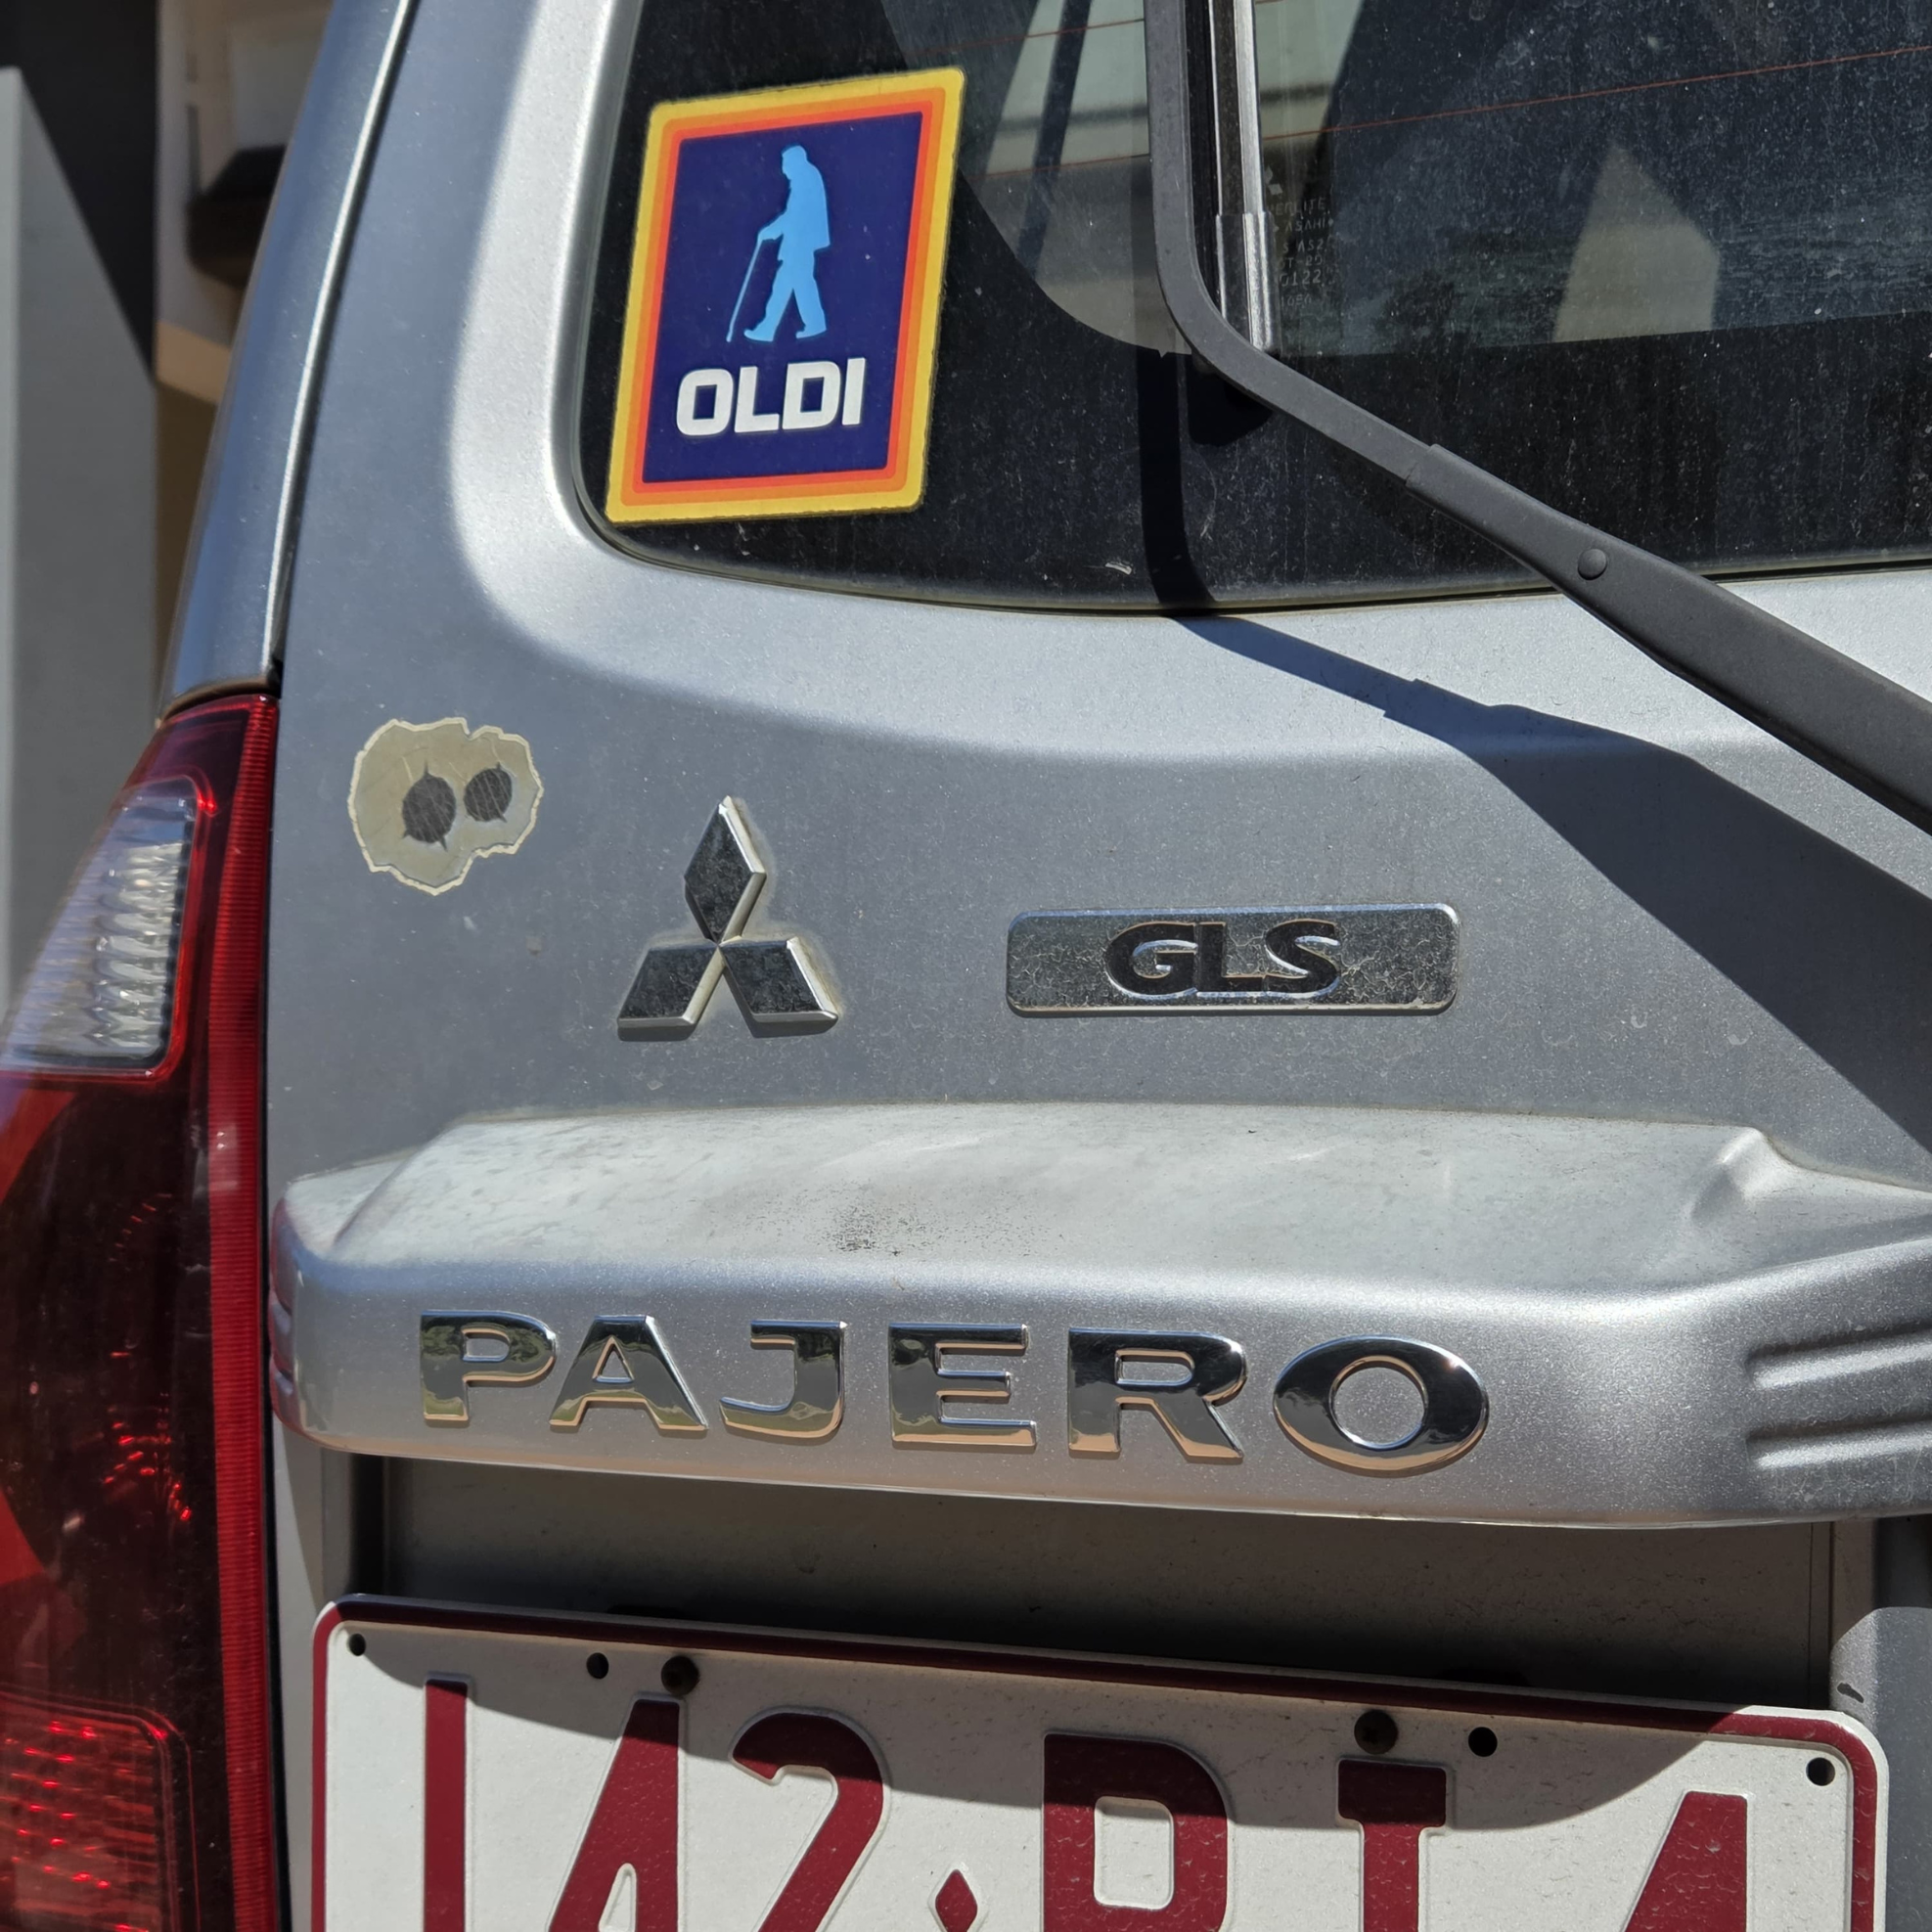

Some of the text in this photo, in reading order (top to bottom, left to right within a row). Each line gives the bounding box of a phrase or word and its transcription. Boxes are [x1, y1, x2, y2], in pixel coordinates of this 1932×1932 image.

[676, 357, 866, 436] OLDI
[1105, 918, 1341, 1001] GLS
[419, 1308, 1491, 1477] PAJERO
